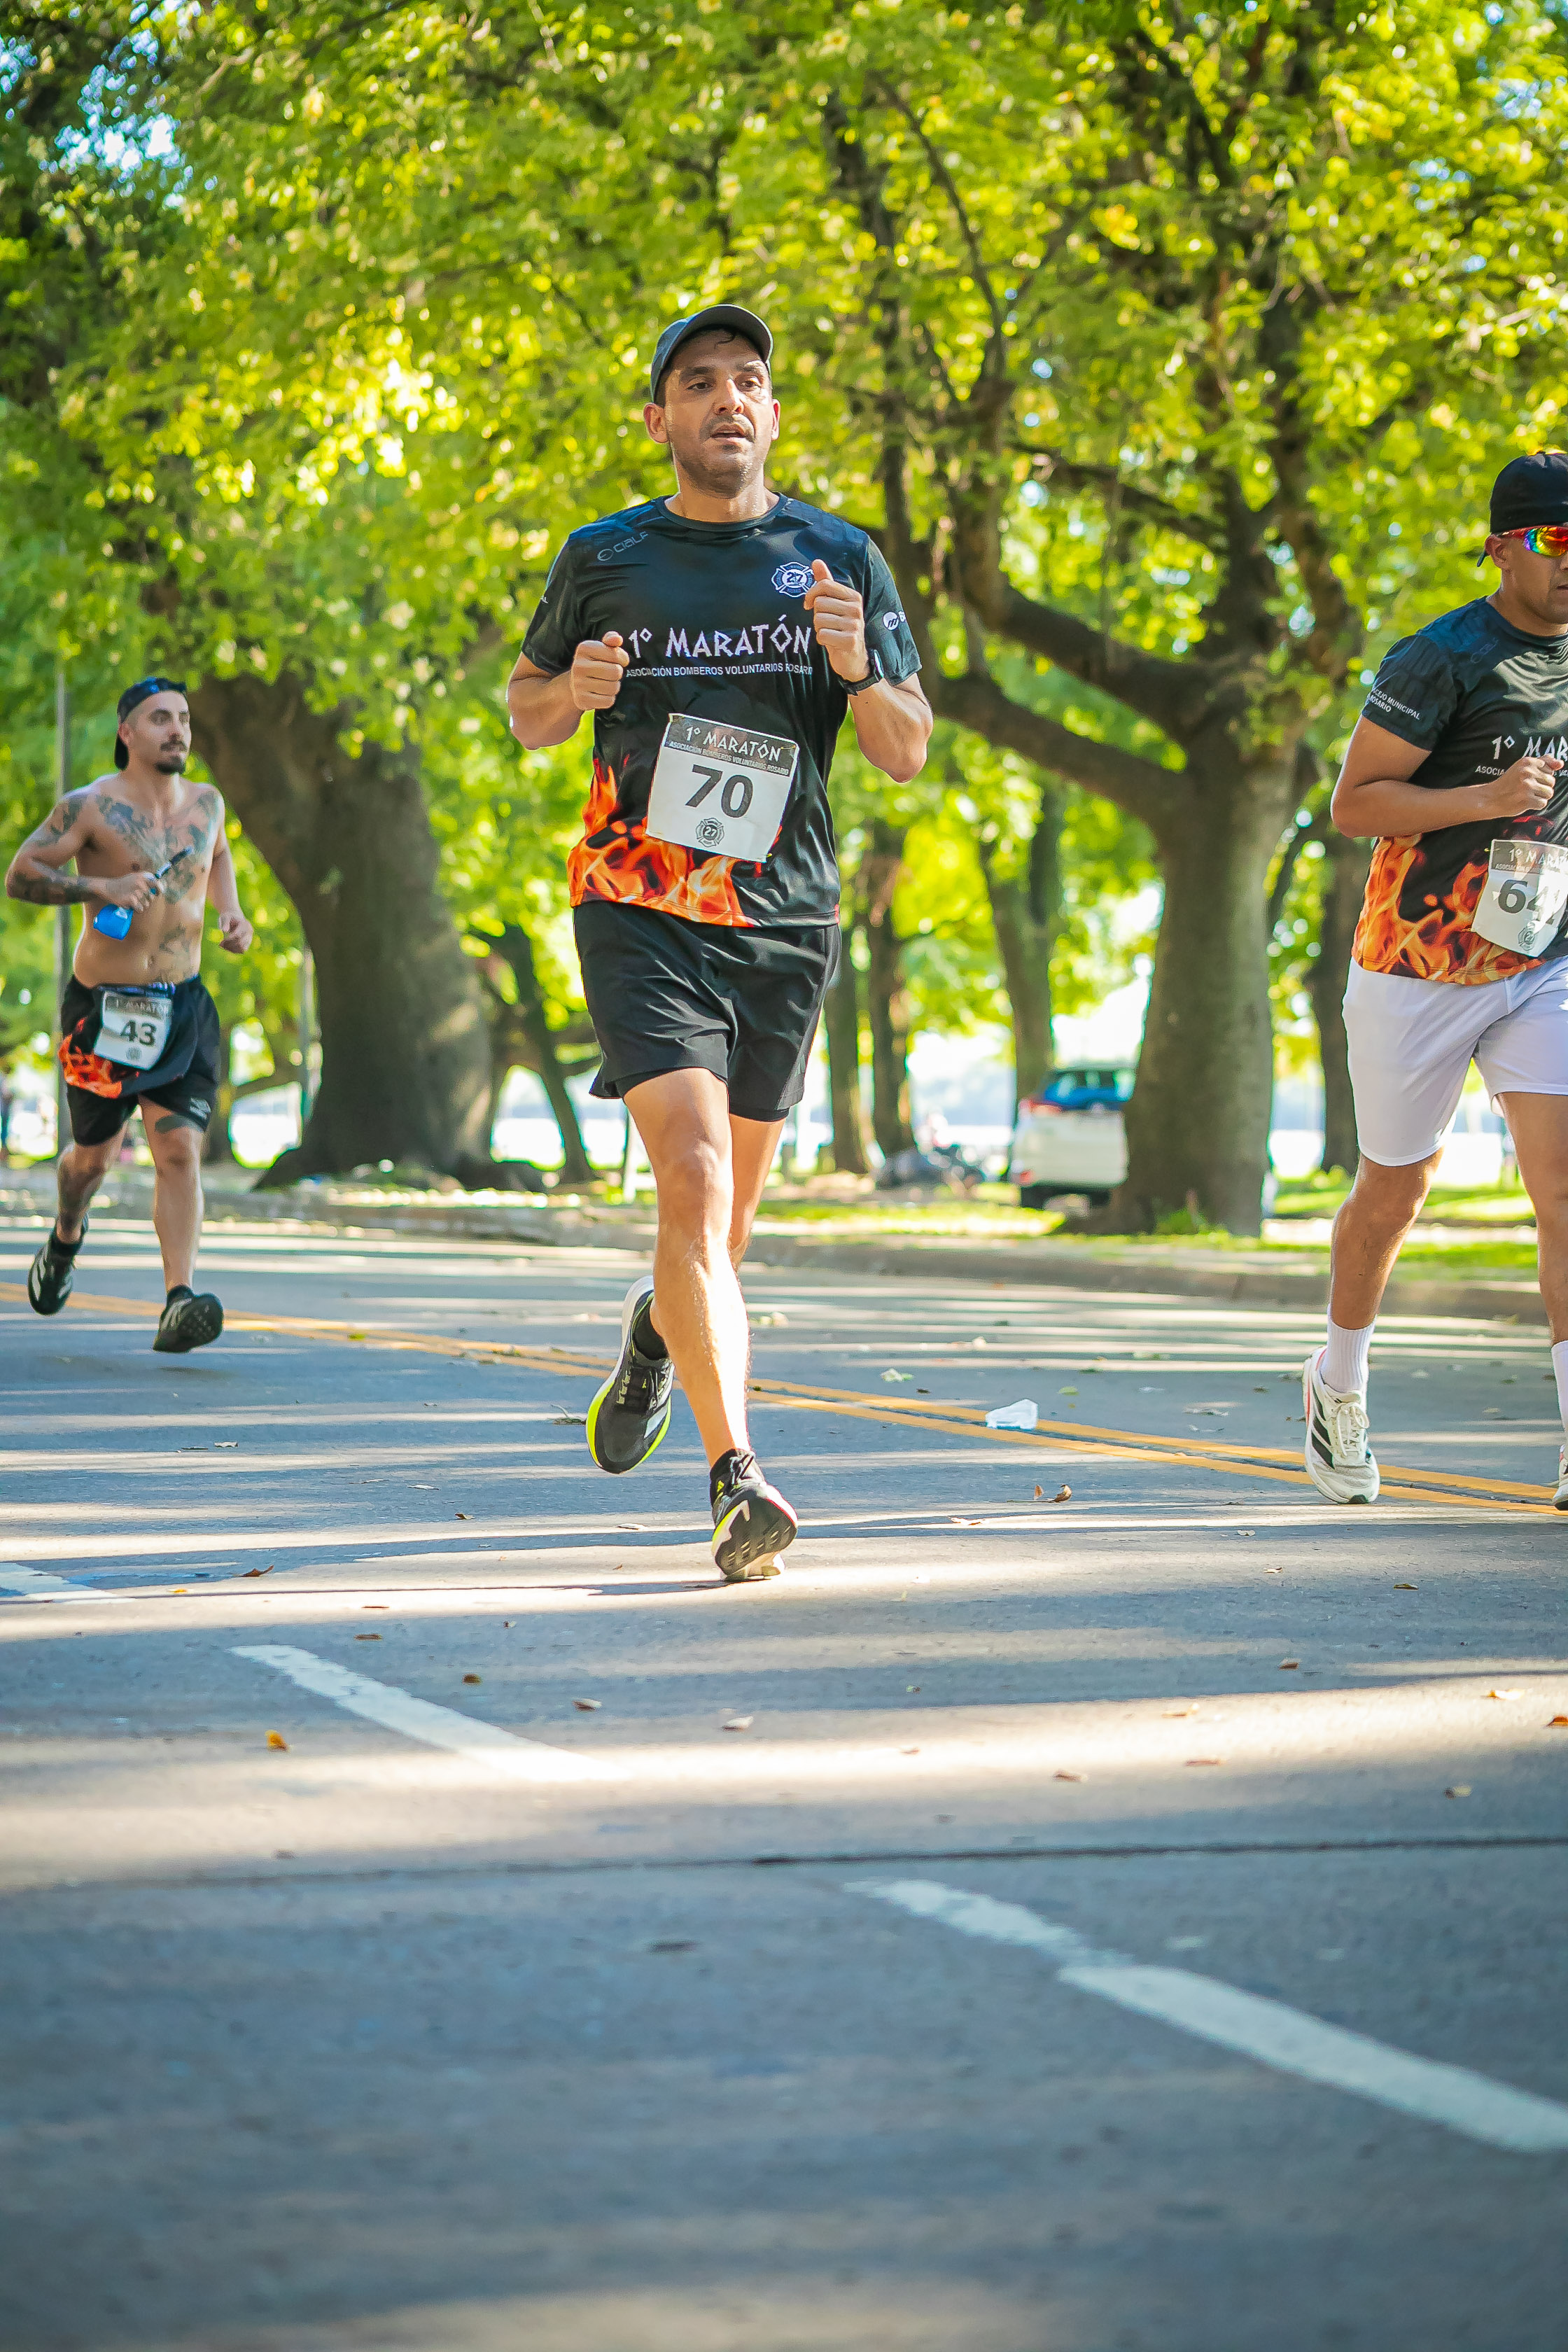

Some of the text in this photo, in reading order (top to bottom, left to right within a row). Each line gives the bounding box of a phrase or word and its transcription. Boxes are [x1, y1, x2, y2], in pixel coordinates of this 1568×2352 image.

[787, 572, 804, 583] 27
[666, 614, 812, 657] MARATÓN
[673, 666, 723, 676] BOMBEROS
[725, 663, 783, 675] VOLUNTARIOS
[1387, 696, 1420, 720] MUNICIPAL
[703, 731, 781, 762] MARATÓN
[685, 764, 753, 818] 70
[704, 826, 717, 837] 27
[120, 1020, 157, 1047] 43
